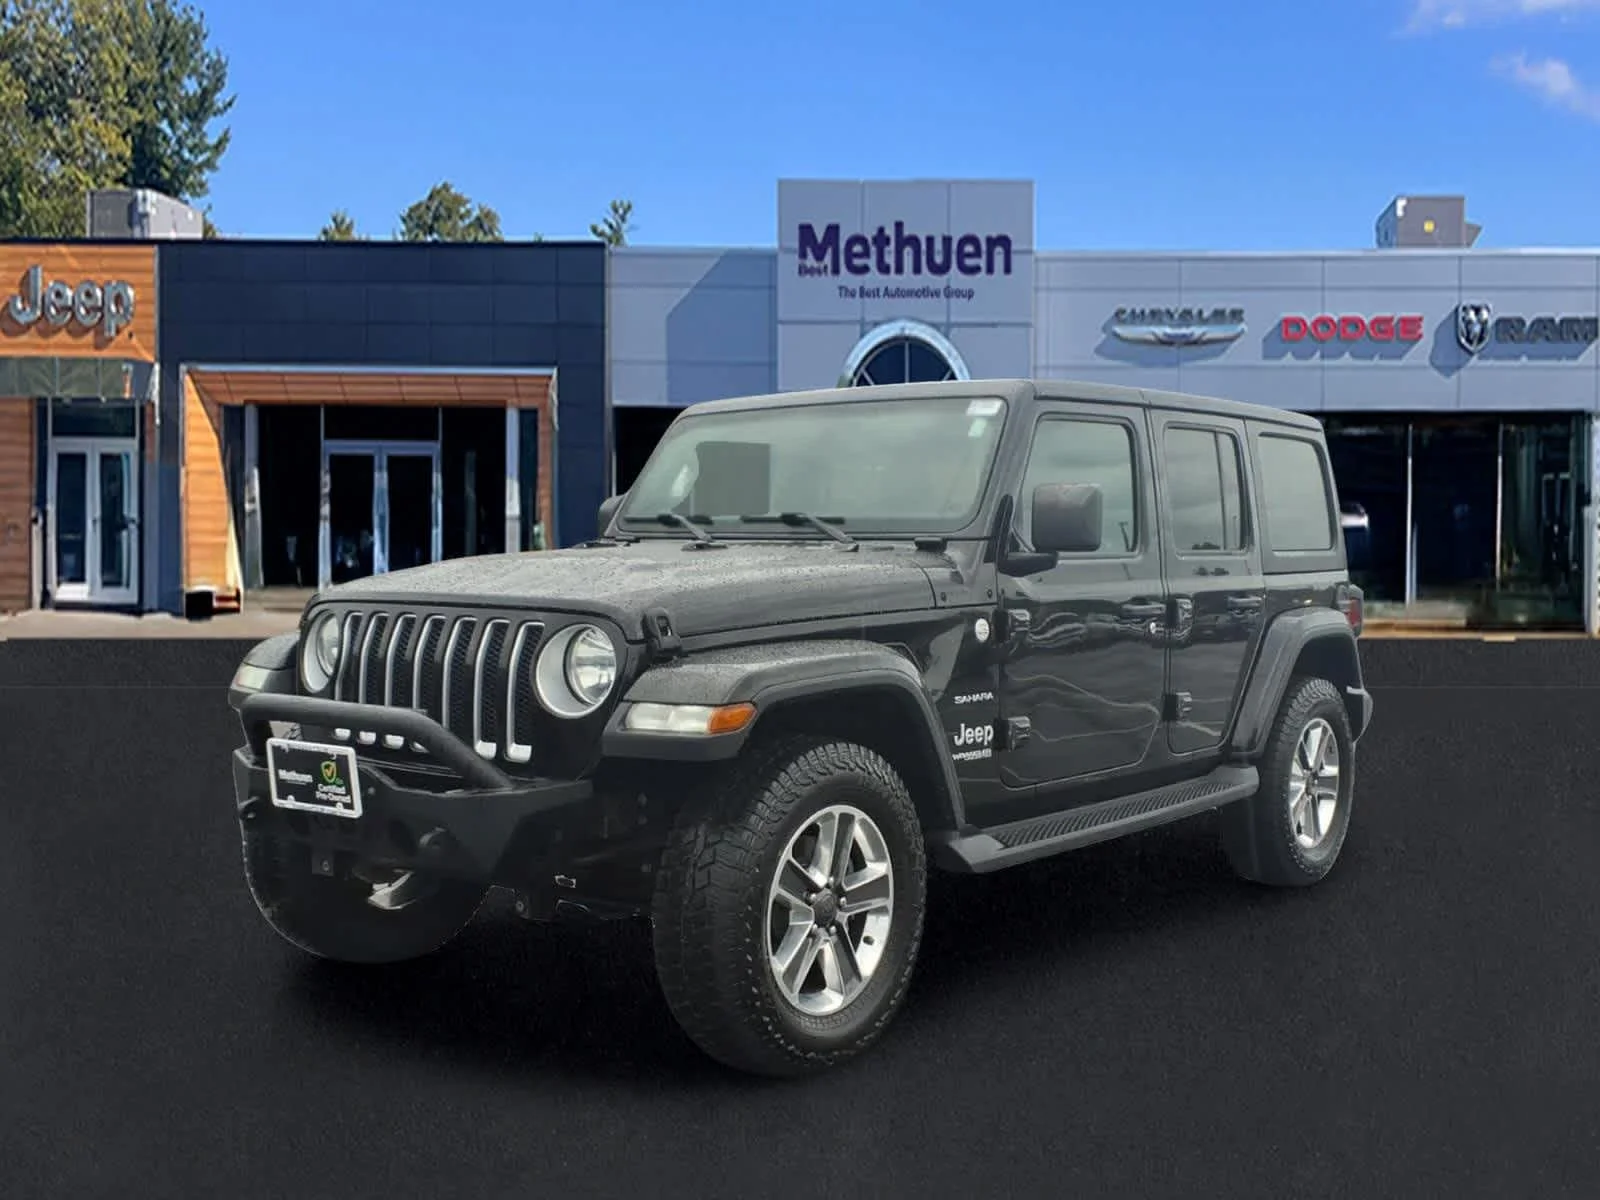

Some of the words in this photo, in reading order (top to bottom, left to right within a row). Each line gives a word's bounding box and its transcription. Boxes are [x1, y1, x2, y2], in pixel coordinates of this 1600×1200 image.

[798, 220, 1012, 275] Methuen
[9, 265, 135, 337] Jeep
[838, 286, 856, 299] The
[859, 286, 881, 299] Best
[883, 286, 941, 299] Automotive
[943, 286, 975, 301] Group
[1114, 307, 1245, 324] CHRYSLER
[1281, 314, 1425, 342] DODGE
[1495, 315, 1599, 344] RAM
[954, 692, 993, 704] SAHARA
[953, 722, 994, 746] Jeep
